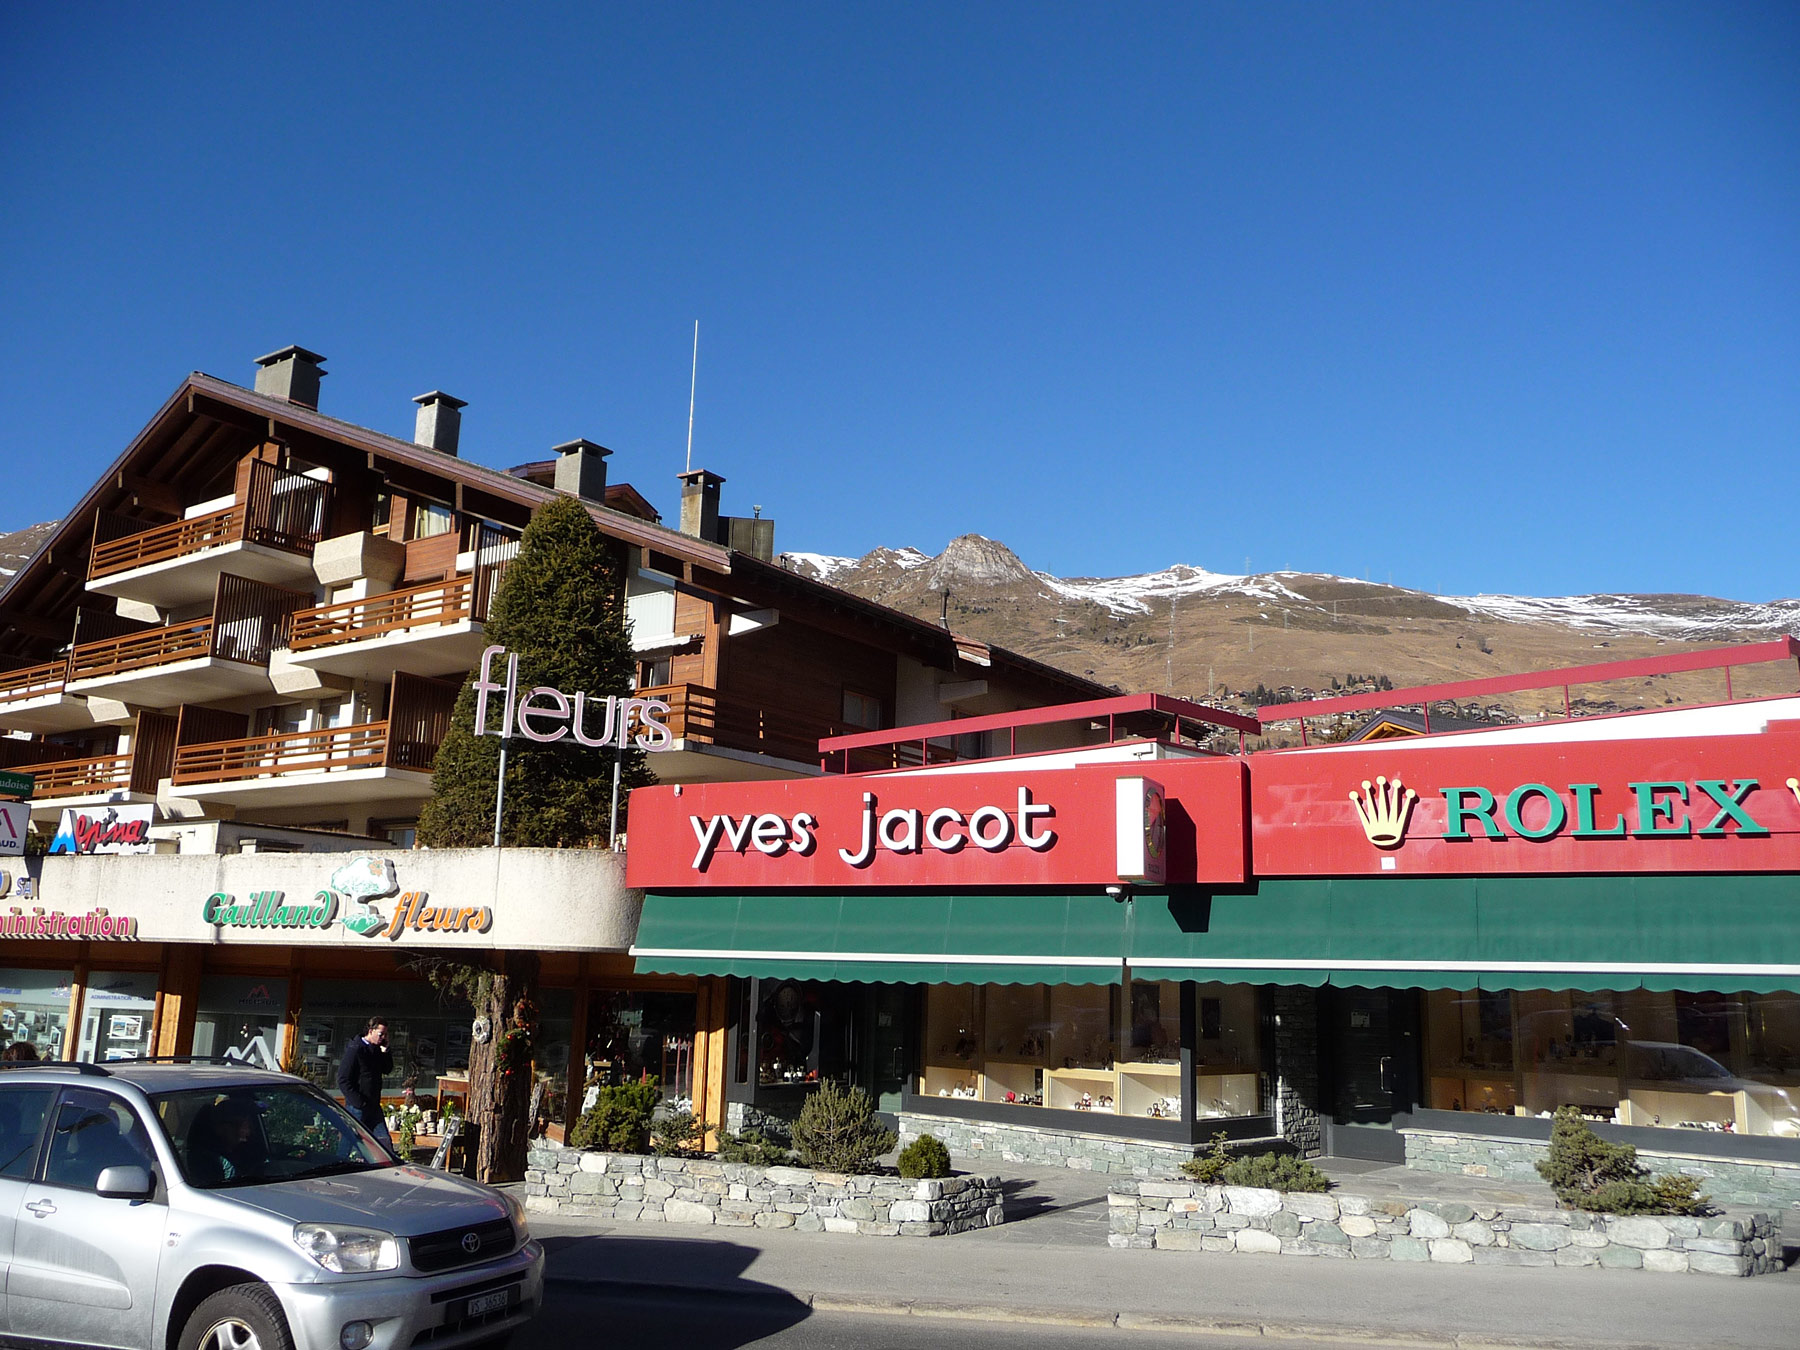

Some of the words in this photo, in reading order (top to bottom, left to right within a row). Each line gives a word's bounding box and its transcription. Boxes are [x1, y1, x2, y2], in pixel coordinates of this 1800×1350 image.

[473, 645, 673, 752] fleurs
[49, 808, 144, 853] Alpina
[689, 811, 815, 868] yves
[838, 786, 1054, 866] jacot
[1439, 778, 1769, 838] ROLEX
[0, 906, 130, 937] inistration
[203, 890, 333, 927] Gailland
[381, 891, 486, 938] fleurs
